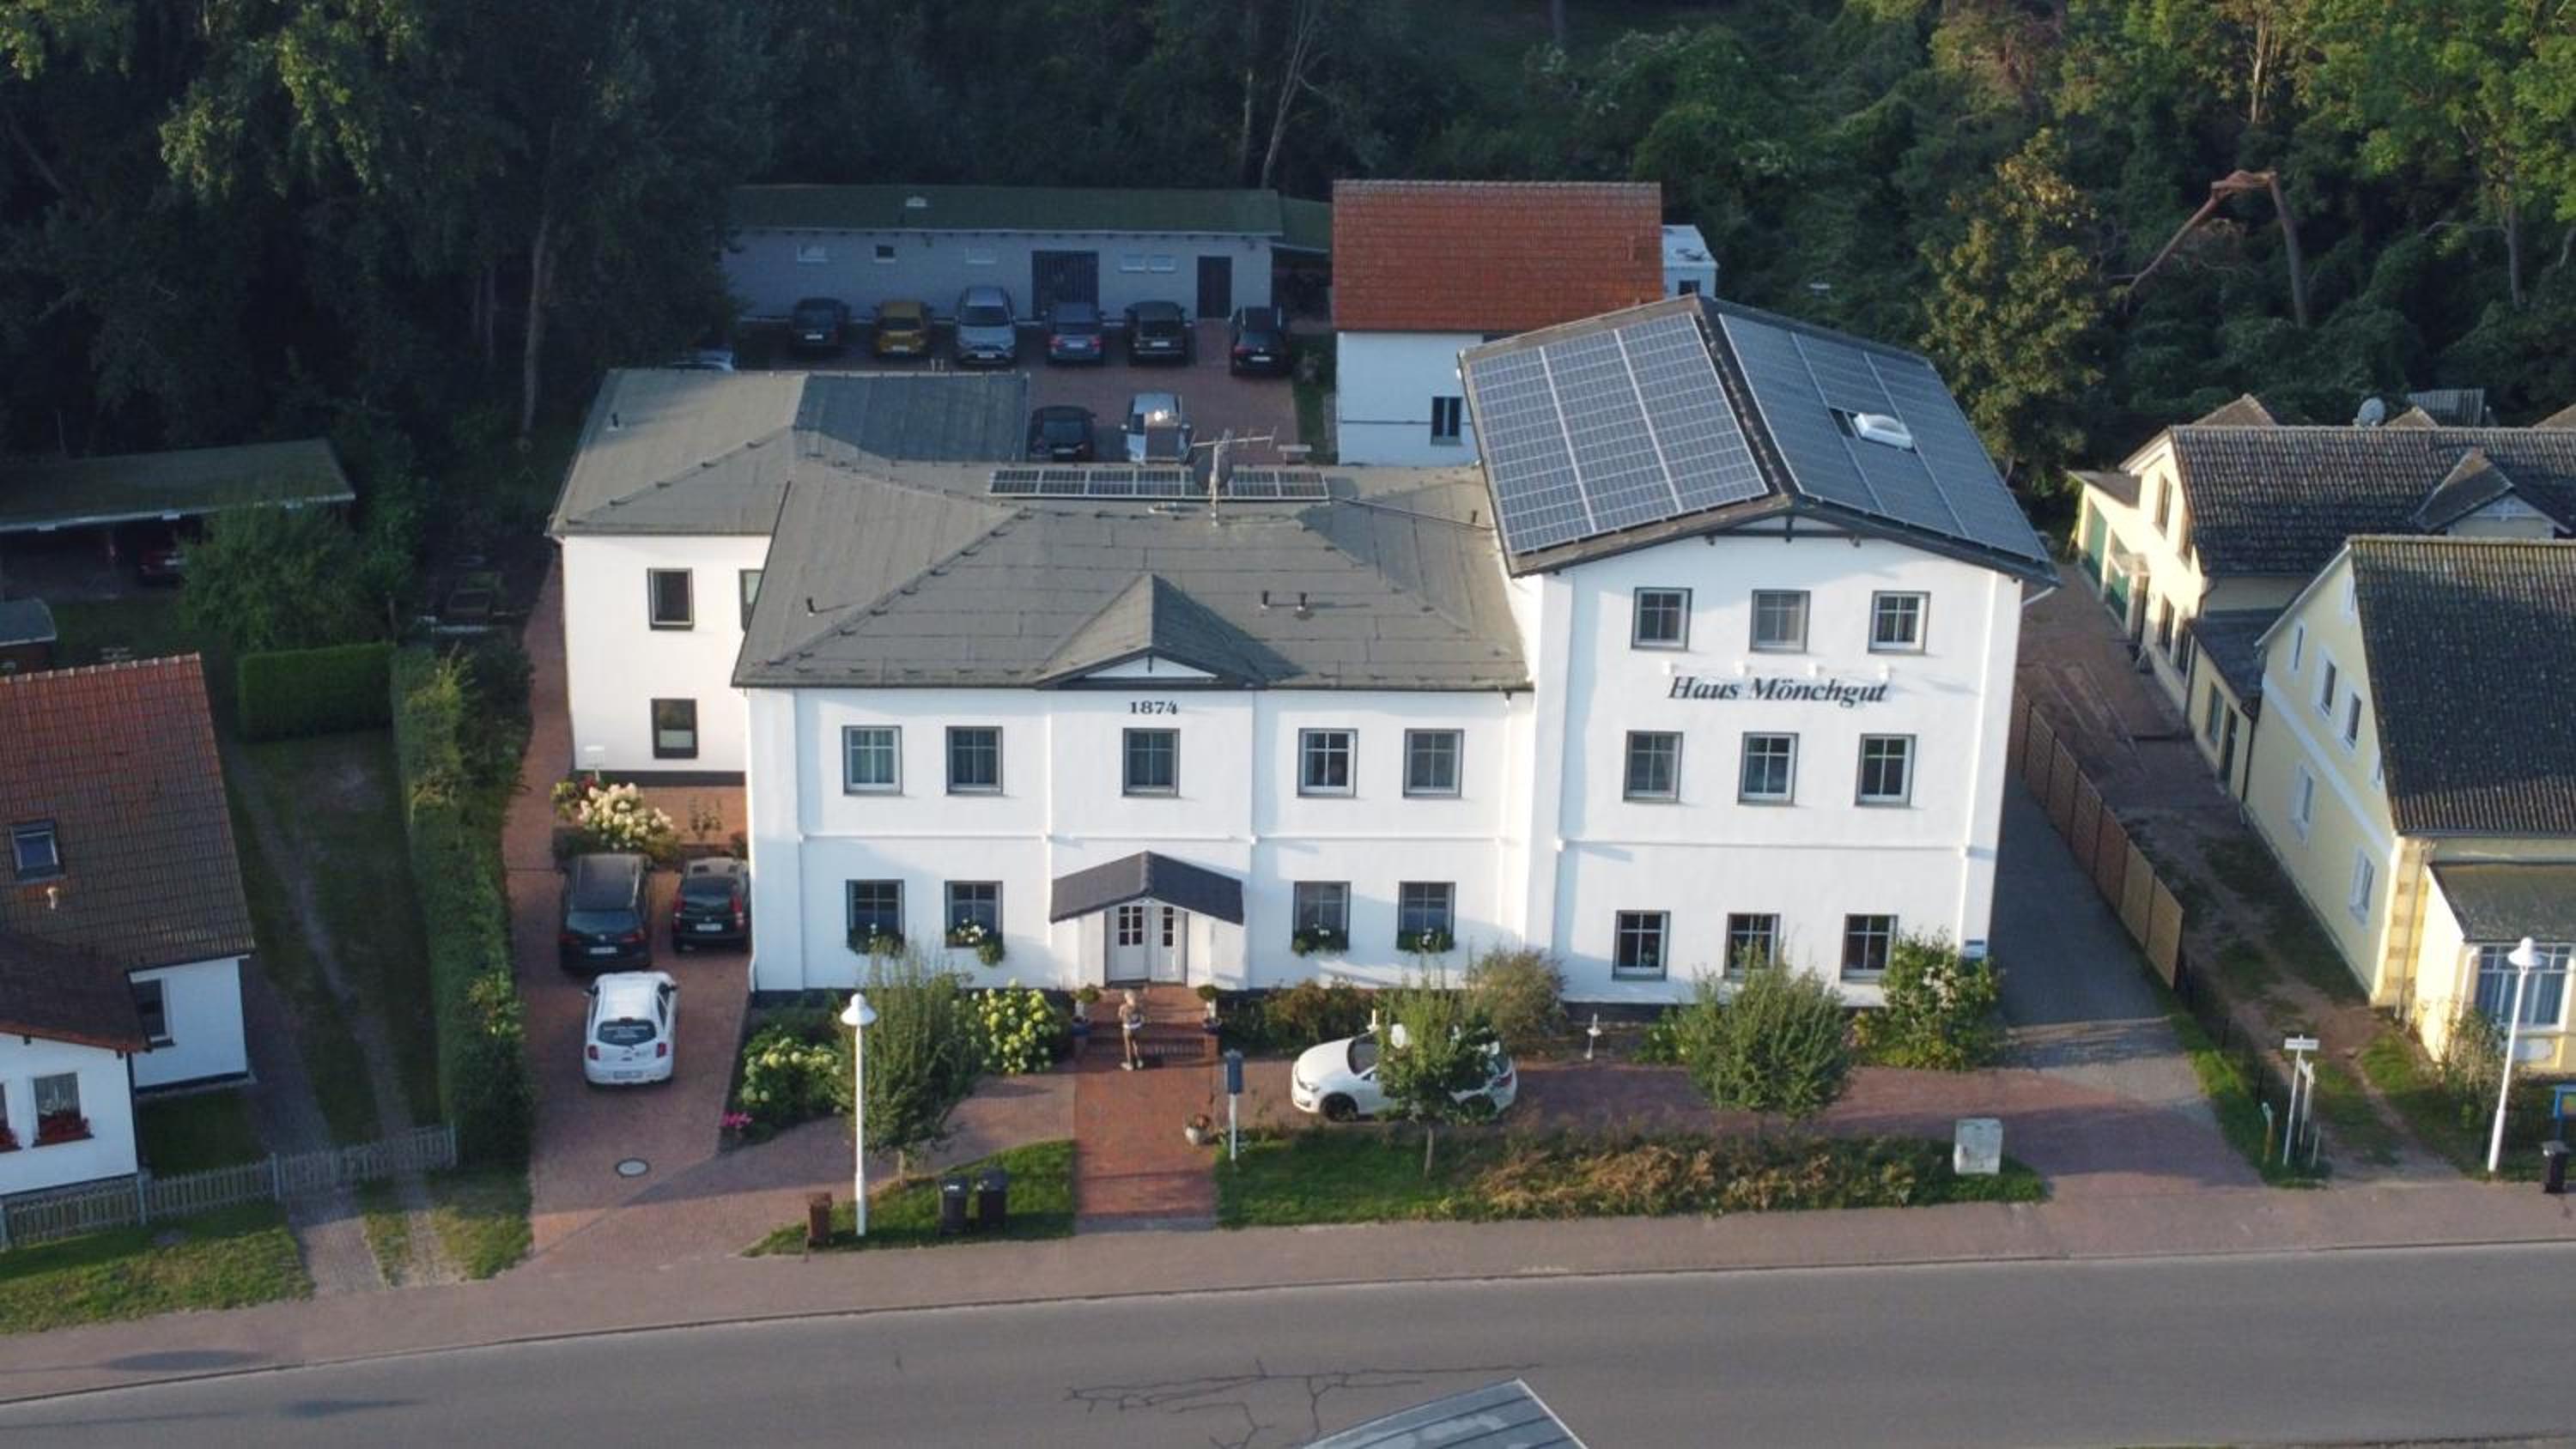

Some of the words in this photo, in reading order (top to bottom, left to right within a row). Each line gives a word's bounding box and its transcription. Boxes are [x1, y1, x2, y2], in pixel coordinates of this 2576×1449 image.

[1668, 676, 1741, 700] Haus
[1747, 676, 1888, 708] Mönchgut
[1130, 700, 1177, 714] 1874
